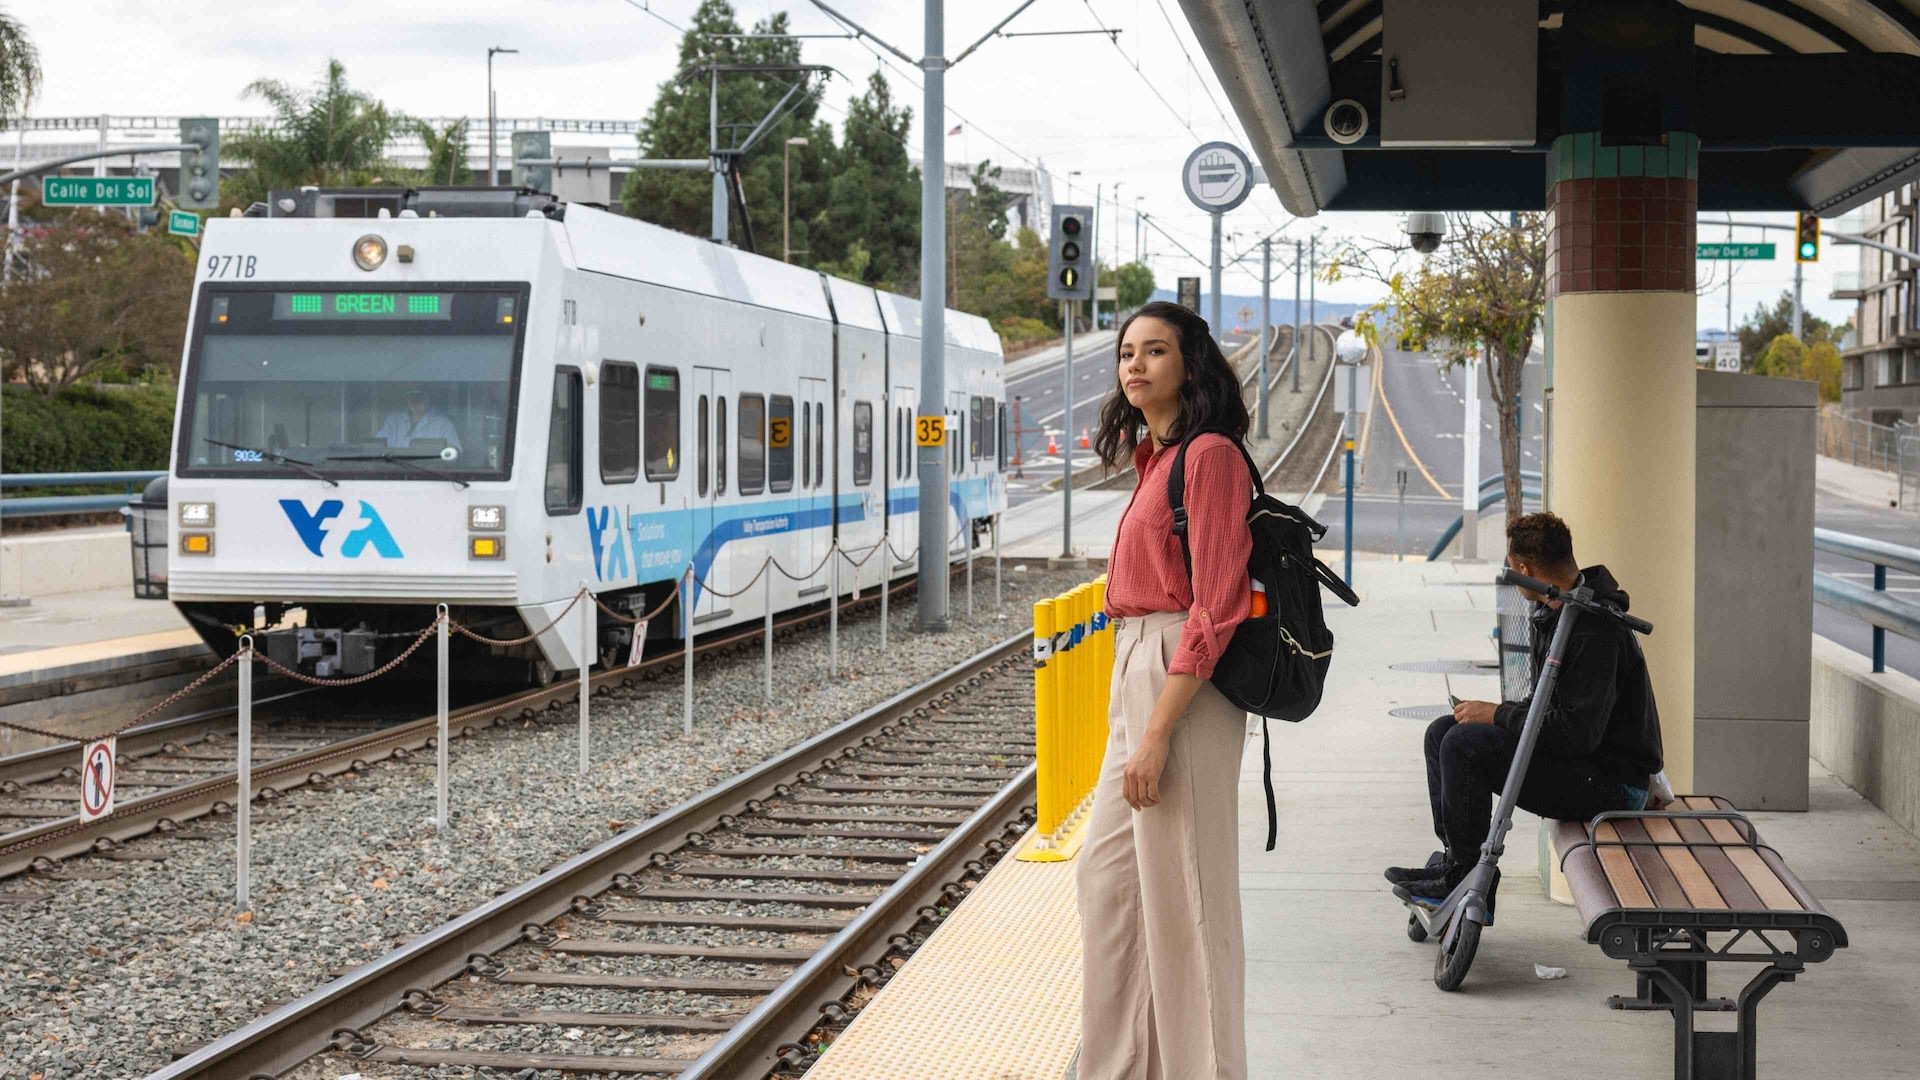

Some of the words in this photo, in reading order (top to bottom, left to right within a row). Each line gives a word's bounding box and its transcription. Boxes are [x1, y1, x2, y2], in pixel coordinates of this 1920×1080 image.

[49, 182, 88, 198] Calle
[95, 182, 120, 198] Del
[126, 182, 150, 198] Sol
[1722, 246, 1740, 257] Del
[1742, 246, 1759, 257] Sol
[207, 255, 258, 278] 971B
[334, 294, 395, 313] GREEN
[1717, 357, 1739, 369] 40
[918, 419, 942, 442] 35
